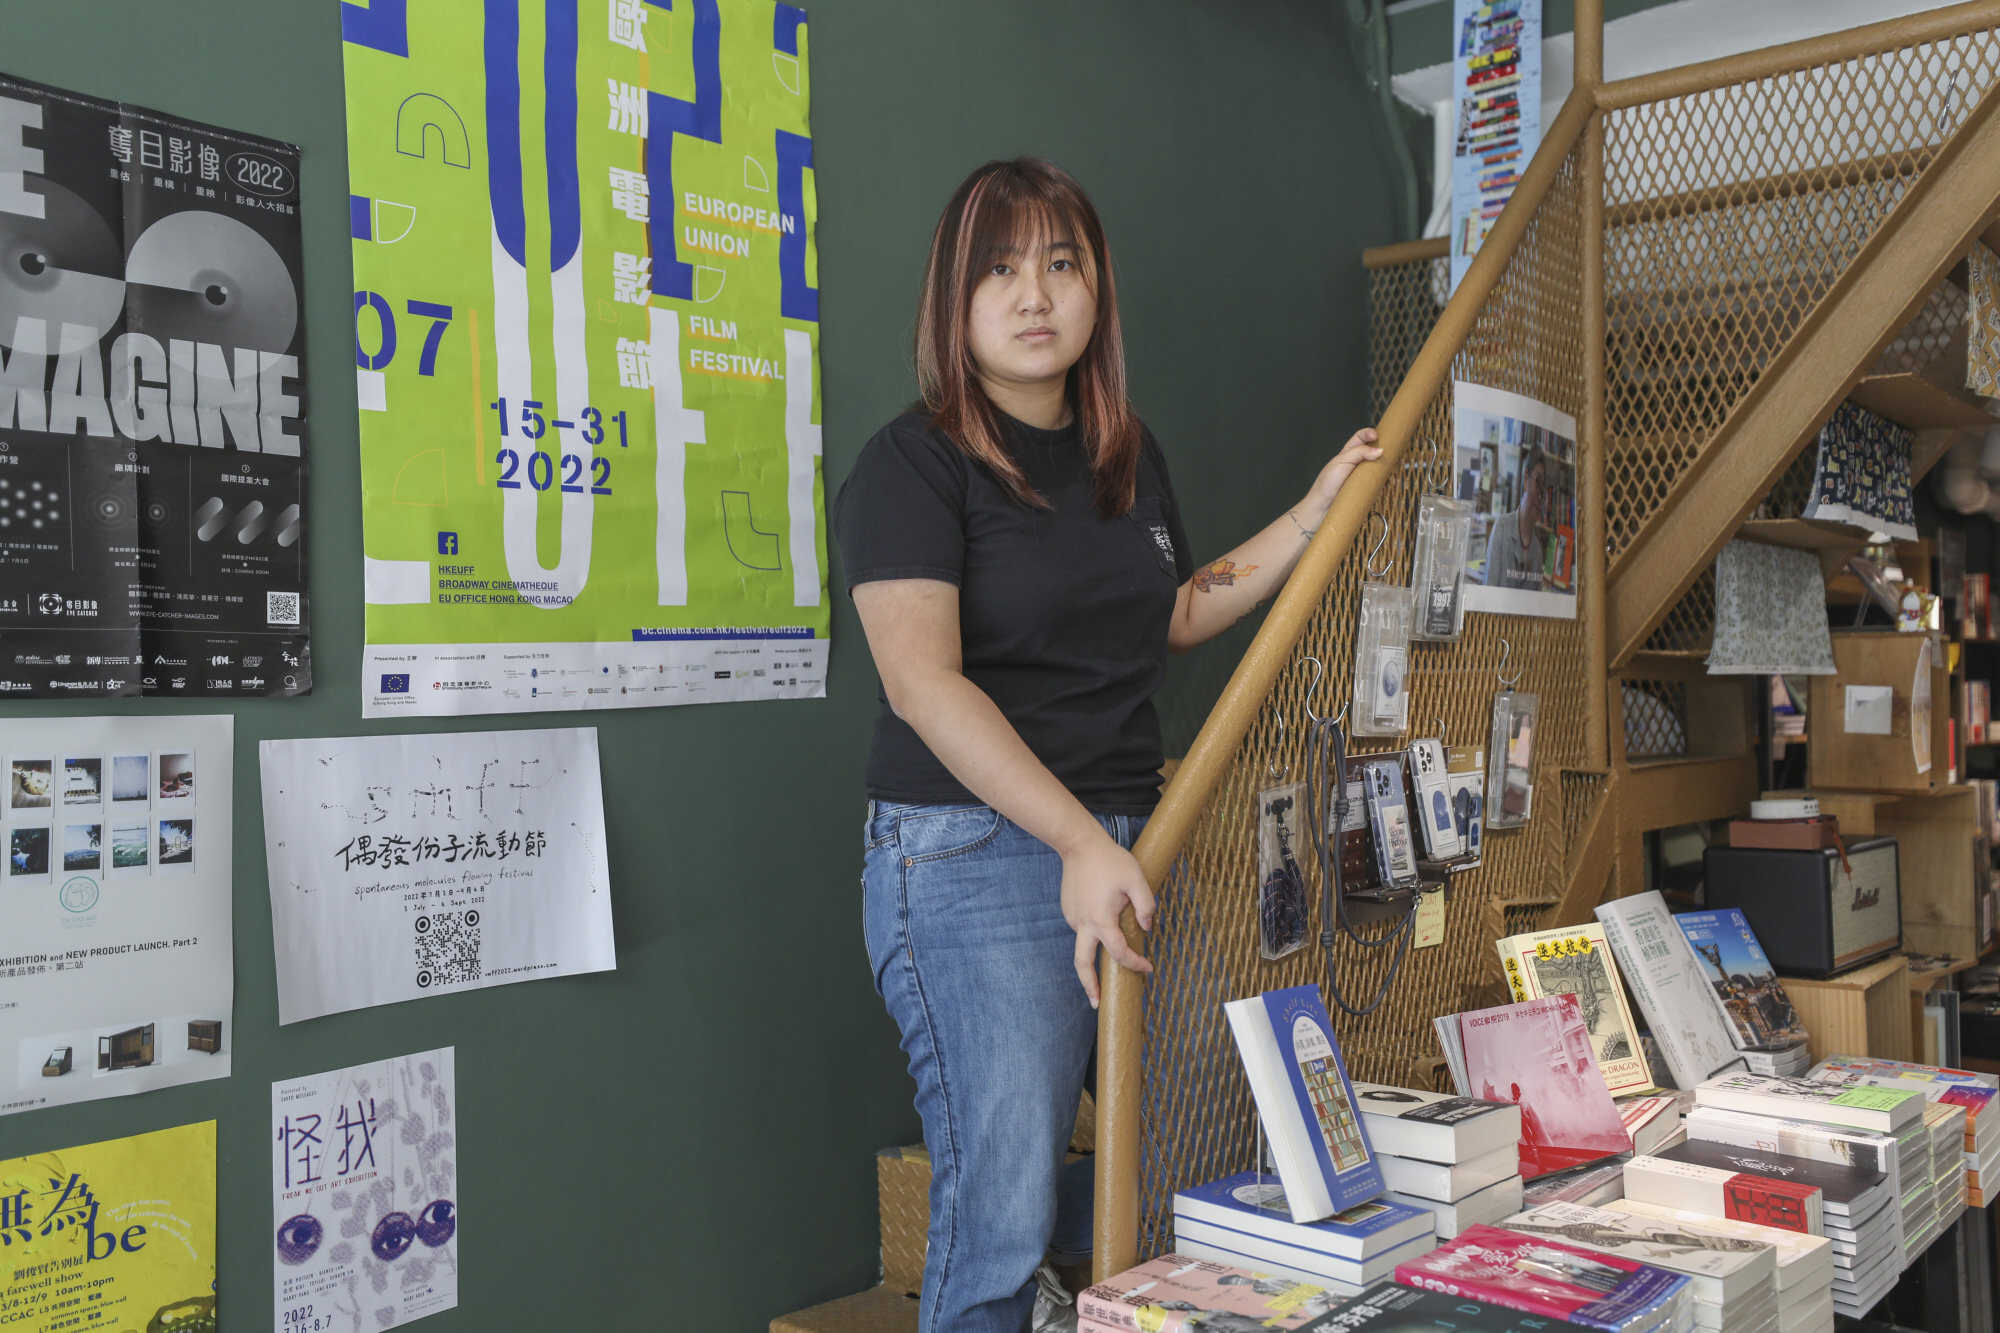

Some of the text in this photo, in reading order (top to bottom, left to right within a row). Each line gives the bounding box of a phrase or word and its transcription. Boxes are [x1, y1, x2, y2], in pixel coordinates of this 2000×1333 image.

[108, 125, 221, 183] 奪目影像
[237, 157, 284, 192] 2022
[684, 191, 795, 235] EUROPEAN
[684, 227, 750, 258] UNION
[354, 289, 453, 377] 07
[689, 315, 738, 341] FILM
[689, 348, 785, 381] FESTIVAL
[495, 448, 612, 496] 2022
[438, 565, 475, 575] HKEUFF
[438, 580, 559, 591] BROADWAY CINEMATHEQUE
[438, 594, 573, 605] EU OFFICE HONG KONG MACAO
[335, 830, 548, 873] 偶發份子流動節
[354, 868, 534, 900] spontaneous molecules flowing festival
[49, 953, 64, 962] and
[65, 949, 88, 960] NEW
[90, 943, 132, 958] PRODUCT
[172, 938, 191, 948] Part
[192, 936, 199, 946] 2
[1607, 1061, 1640, 1074] DRAGON
[278, 1097, 378, 1190] 怪我
[316, 1183, 328, 1194] OUT
[330, 1180, 343, 1190] ART
[344, 1171, 378, 1185] EXHIBITION
[86, 1200, 147, 1263] be
[7, 1271, 84, 1296] farewell show
[55, 1276, 115, 1297] 10am-10pm
[283, 1304, 313, 1325] 2022
